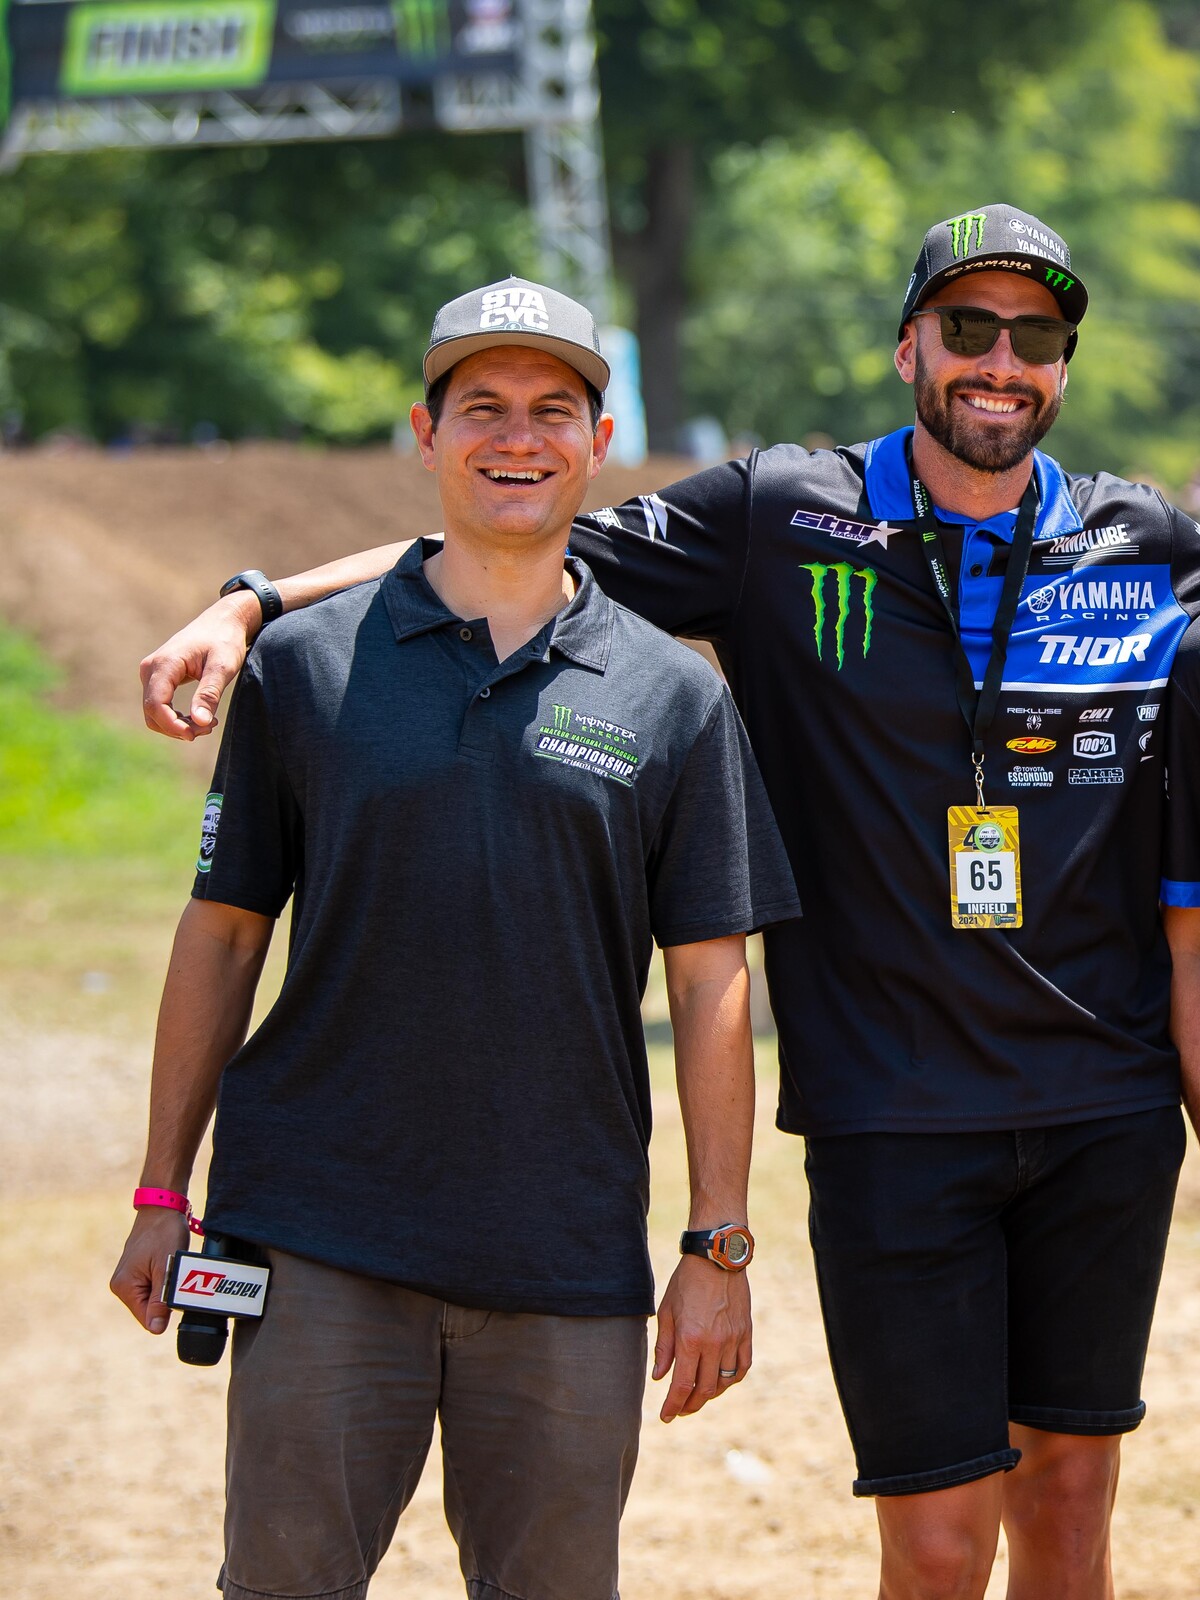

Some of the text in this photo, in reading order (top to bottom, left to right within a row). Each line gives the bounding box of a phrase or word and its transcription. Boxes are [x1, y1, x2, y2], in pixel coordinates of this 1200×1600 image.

[89, 19, 243, 74] FINISH
[1025, 224, 1066, 265] YAMAHA
[961, 259, 1032, 271] YAMAHA
[1049, 524, 1131, 554] YAMALUBE
[1059, 581, 1155, 610] YAMAHA
[1036, 612, 1150, 623] RACING
[1037, 633, 1153, 667] THOR
[1006, 706, 1063, 716] REKLUSE
[574, 712, 638, 744] MONSTER
[1006, 739, 1058, 751] FMF
[1078, 737, 1110, 752] 100%
[538, 736, 635, 777] CHAMPIONSHIP
[1008, 771, 1054, 783] ESCONDIDO
[1069, 767, 1124, 779] PARTS
[970, 860, 1003, 892] 65
[967, 903, 1008, 914] INFIELD
[958, 916, 979, 925] 2021
